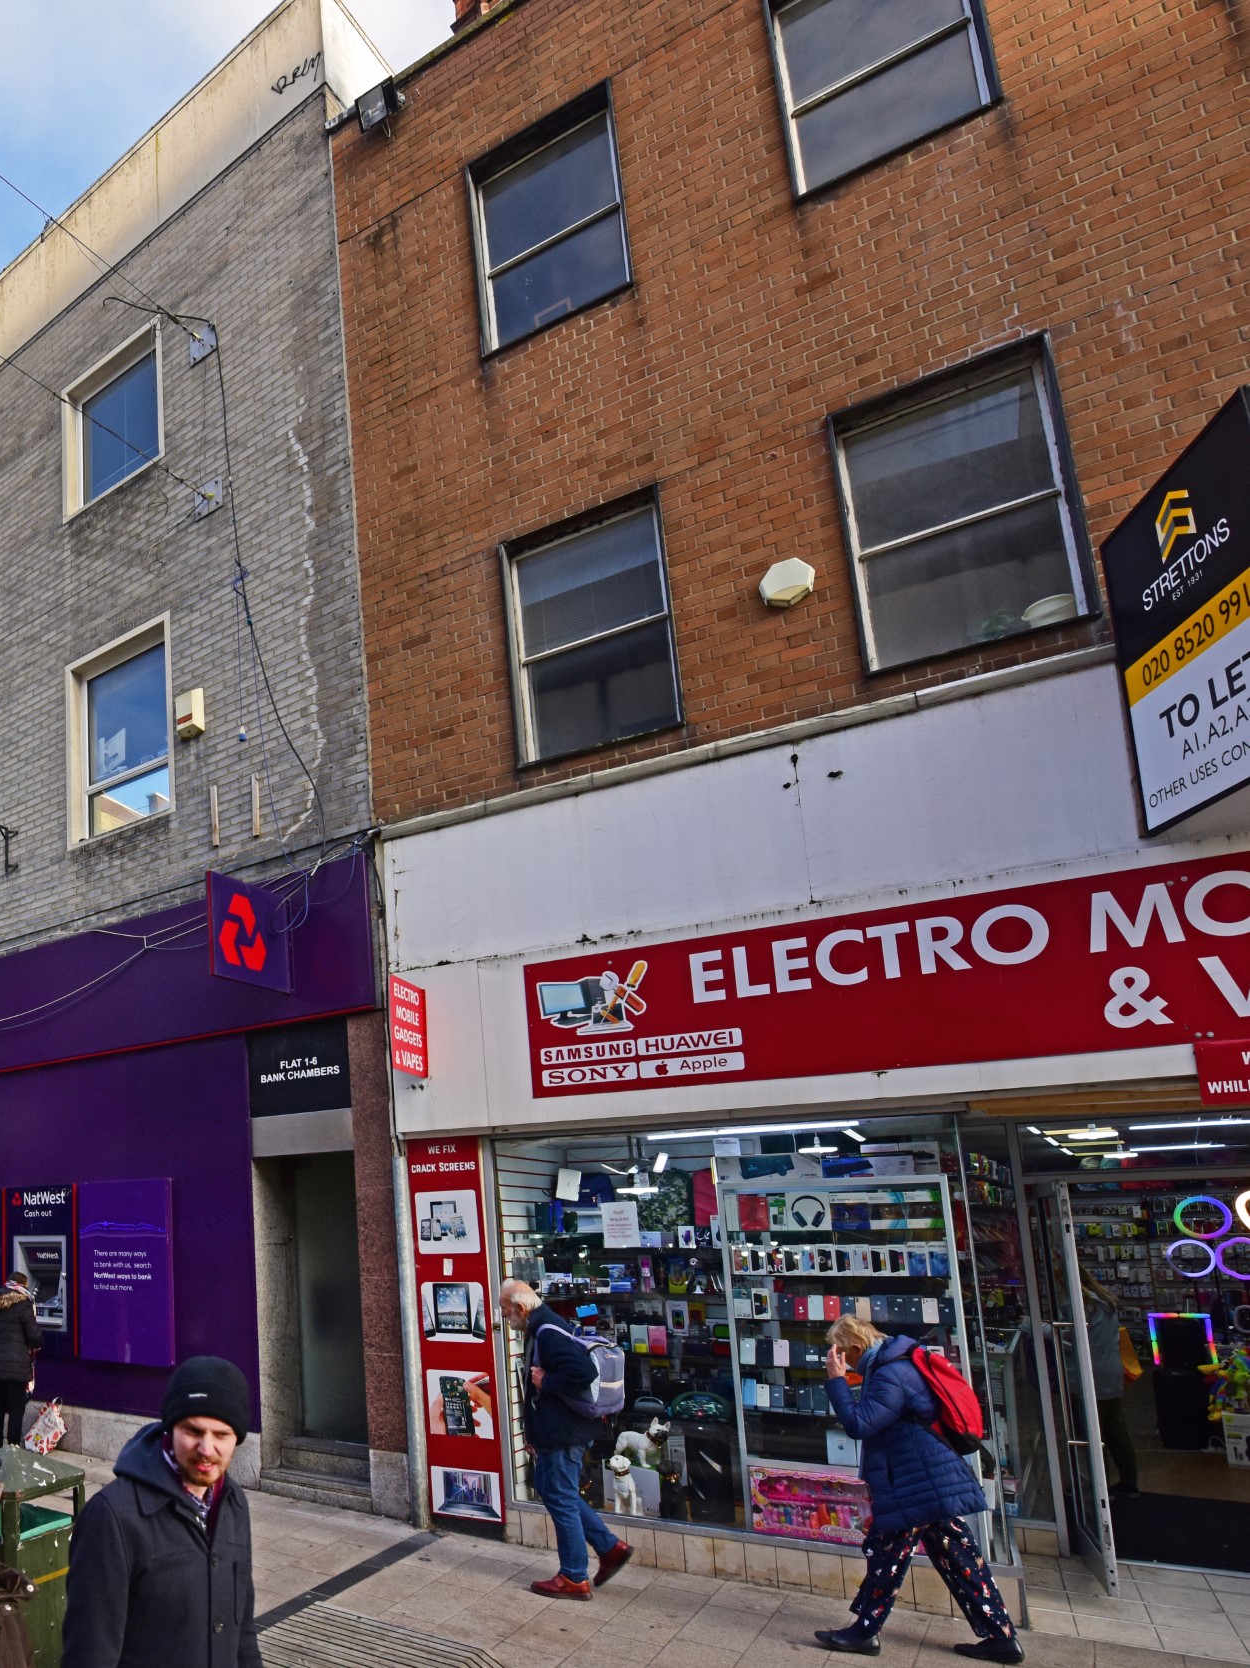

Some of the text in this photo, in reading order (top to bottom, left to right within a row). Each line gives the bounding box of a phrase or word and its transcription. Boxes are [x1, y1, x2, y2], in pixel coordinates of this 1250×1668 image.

[1142, 517, 1230, 611] STRETTONS
[1171, 569, 1203, 601] EST 1931
[1142, 648, 1170, 686] 020
[1173, 612, 1215, 662] 8520
[1159, 693, 1200, 739] TO
[1149, 777, 1188, 809] OTHER
[1189, 758, 1219, 785] USES
[688, 903, 1050, 1004] ELECTRO
[393, 982, 419, 1006] ELECTRO
[1103, 966, 1175, 1029] &
[395, 1005, 419, 1027] MOBILE
[394, 1025, 423, 1048] GADGETS
[644, 1030, 735, 1053] HUAWEI
[279, 1056, 318, 1070] FLAT 1-6
[395, 1049, 424, 1072] & VAPES
[543, 1041, 634, 1063] SAMSUNG
[260, 1064, 340, 1084] BANK CHAMBERS
[548, 1064, 630, 1085] SONY
[679, 1055, 728, 1072] Apple
[427, 1144, 456, 1155] WE FIX
[411, 1161, 476, 1174] CRACK SCREENS
[23, 1190, 66, 1206] NatWest
[24, 1209, 53, 1218] Cash out
[94, 1249, 108, 1257] There
[133, 1251, 147, 1259] ways
[133, 1261, 152, 1269] search
[93, 1271, 116, 1279] NatWest
[116, 1273, 131, 1281] ways
[138, 1272, 152, 1280] bank
[100, 1282, 109, 1290] find
